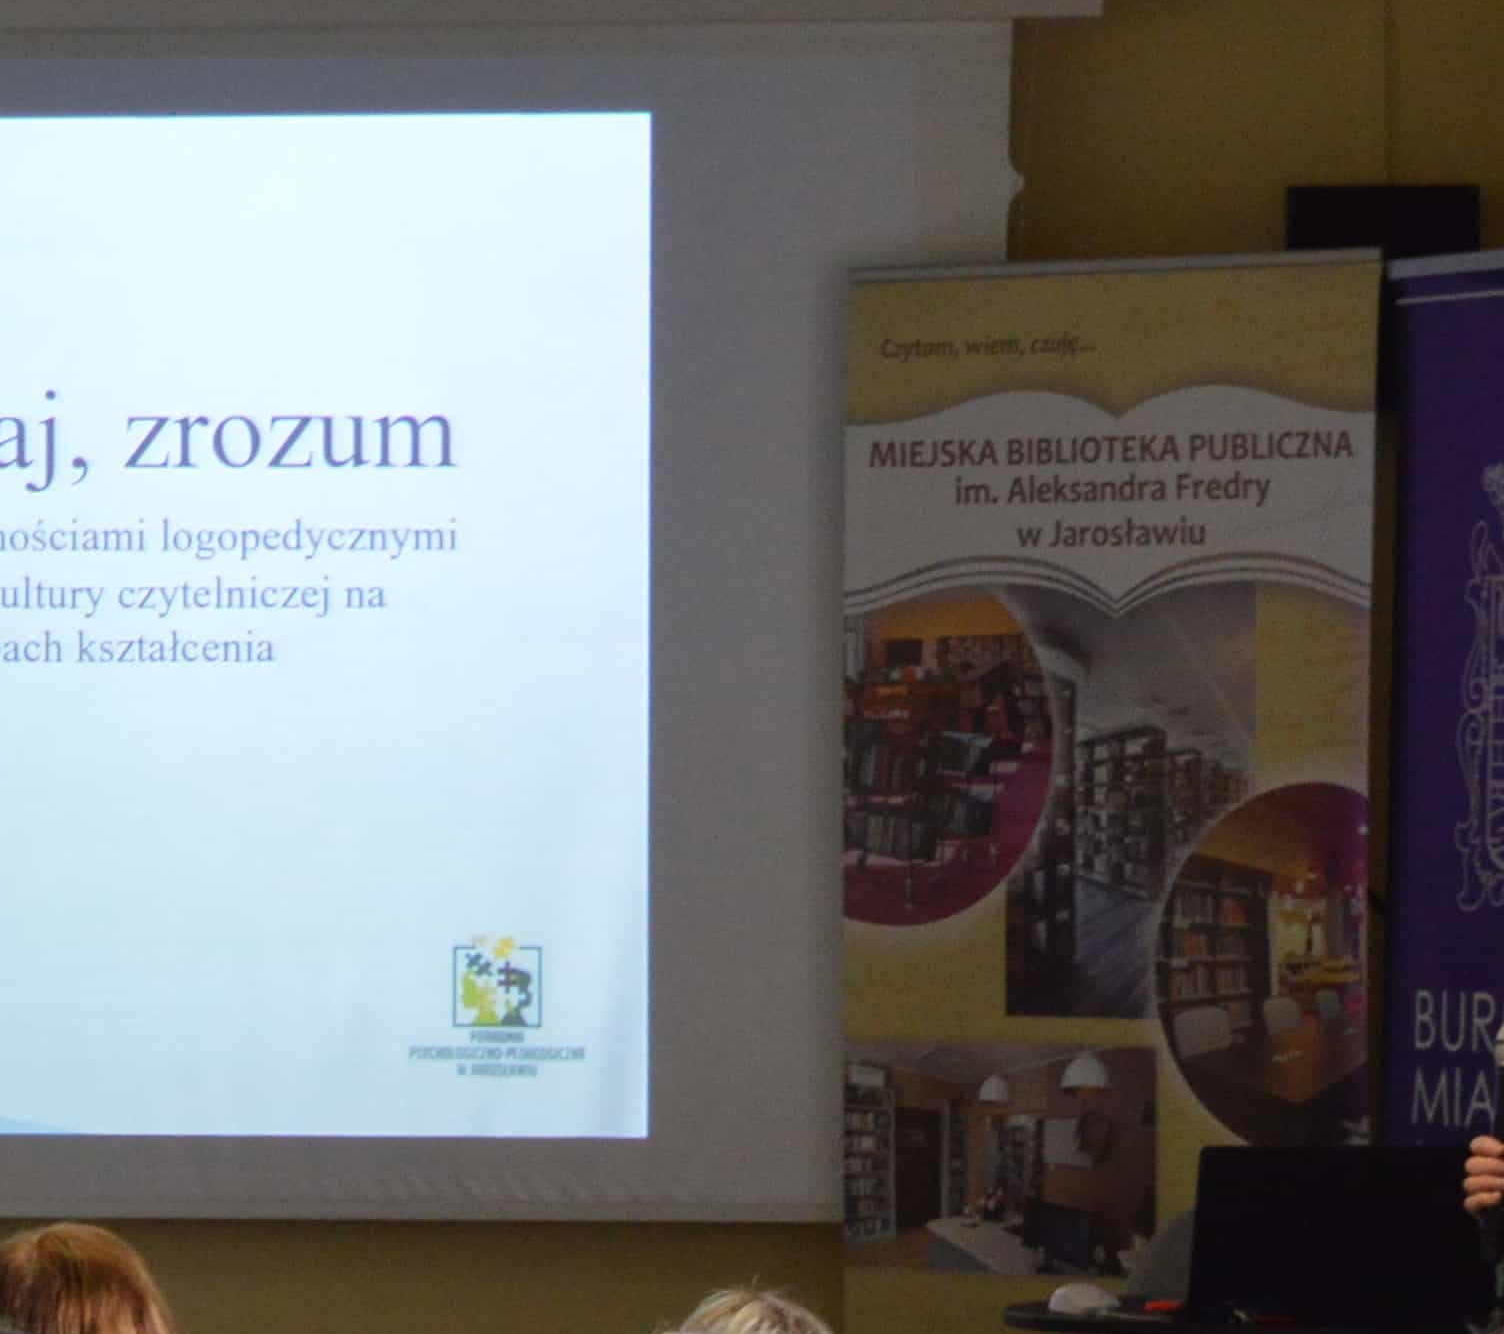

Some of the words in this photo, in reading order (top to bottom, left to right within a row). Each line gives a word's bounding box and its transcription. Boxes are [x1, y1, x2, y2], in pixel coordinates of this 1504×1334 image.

[879, 336, 960, 361] Czytam,
[965, 336, 1025, 358] wiem,
[124, 411, 459, 471] zrozum
[869, 440, 999, 468] MIEJSKA
[1007, 435, 1180, 465] BIBLIOTEKA
[1189, 430, 1354, 461] PUBLICZNA
[954, 477, 999, 505] im.
[1007, 473, 1167, 504] Aleksandra
[1175, 473, 1271, 507] Fredry
[159, 519, 459, 560] logopedycznymi
[1017, 526, 1042, 548] w
[1049, 517, 1207, 548] Jarosławiu
[116, 576, 332, 619] czytelniczej
[343, 585, 387, 610] na
[74, 631, 276, 665] kształcenia
